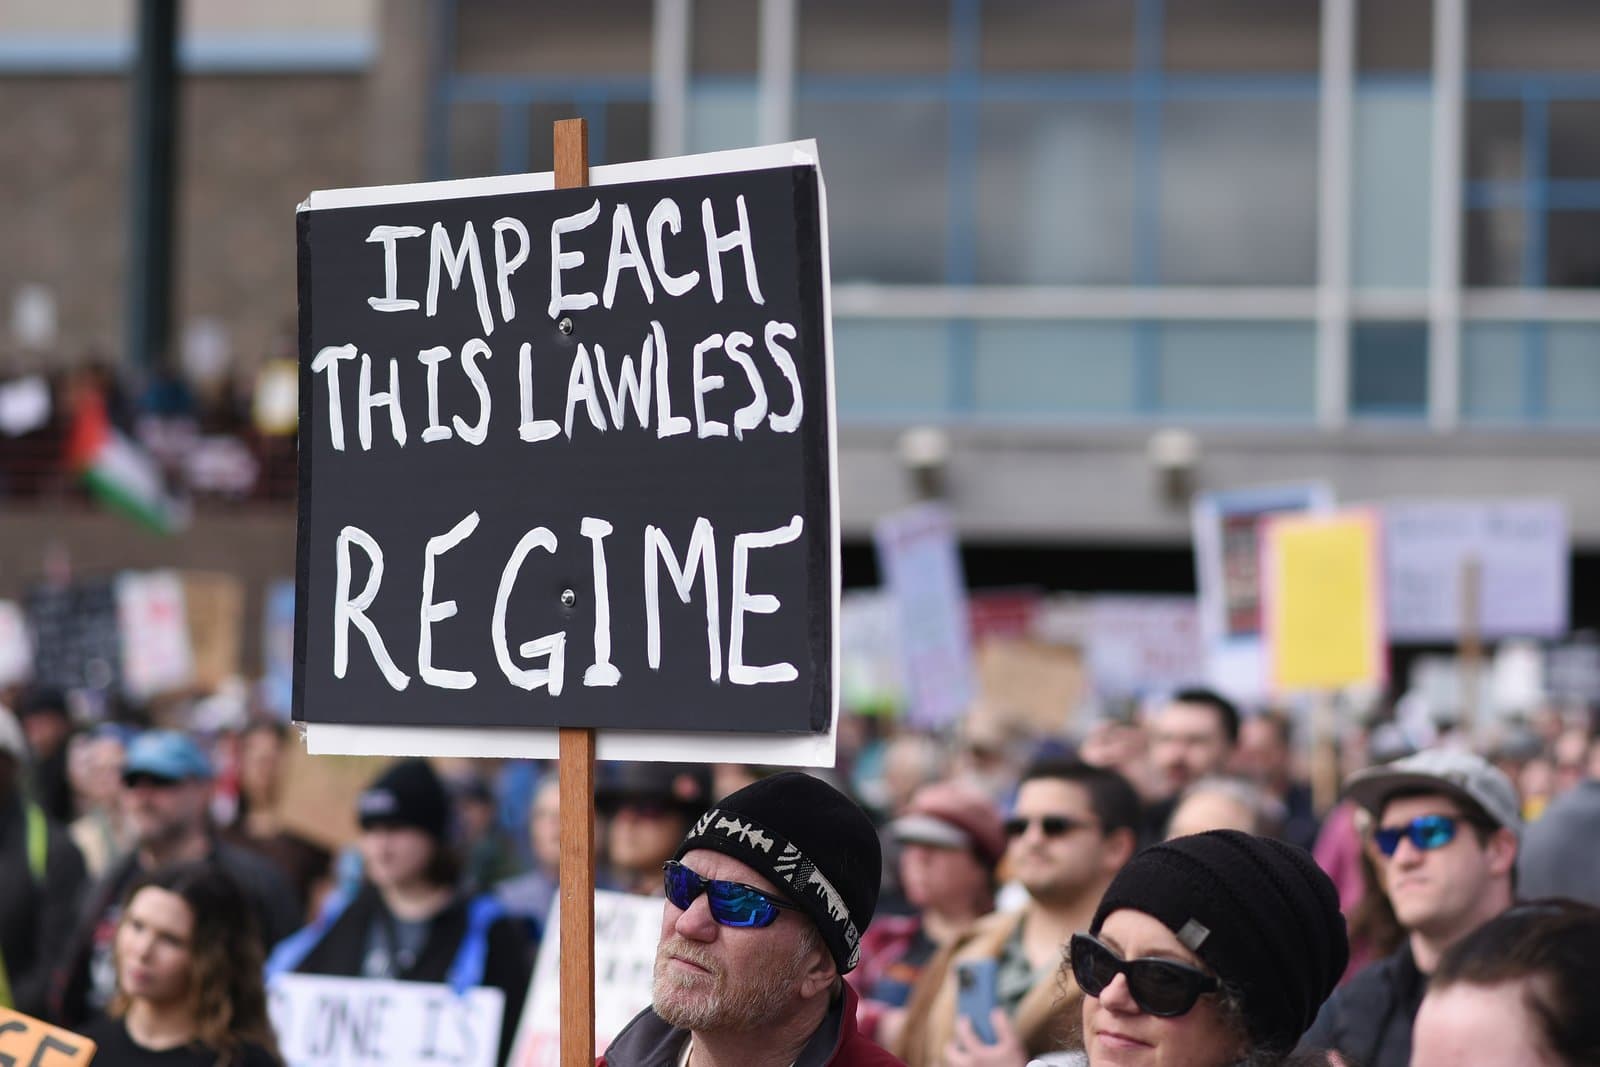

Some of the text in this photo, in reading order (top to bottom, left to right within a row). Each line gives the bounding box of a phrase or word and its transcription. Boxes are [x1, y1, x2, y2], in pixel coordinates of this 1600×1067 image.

[364, 194, 766, 337] IMPEACH
[310, 320, 804, 452] THIS LAWLESS
[333, 510, 803, 697] REGIME
